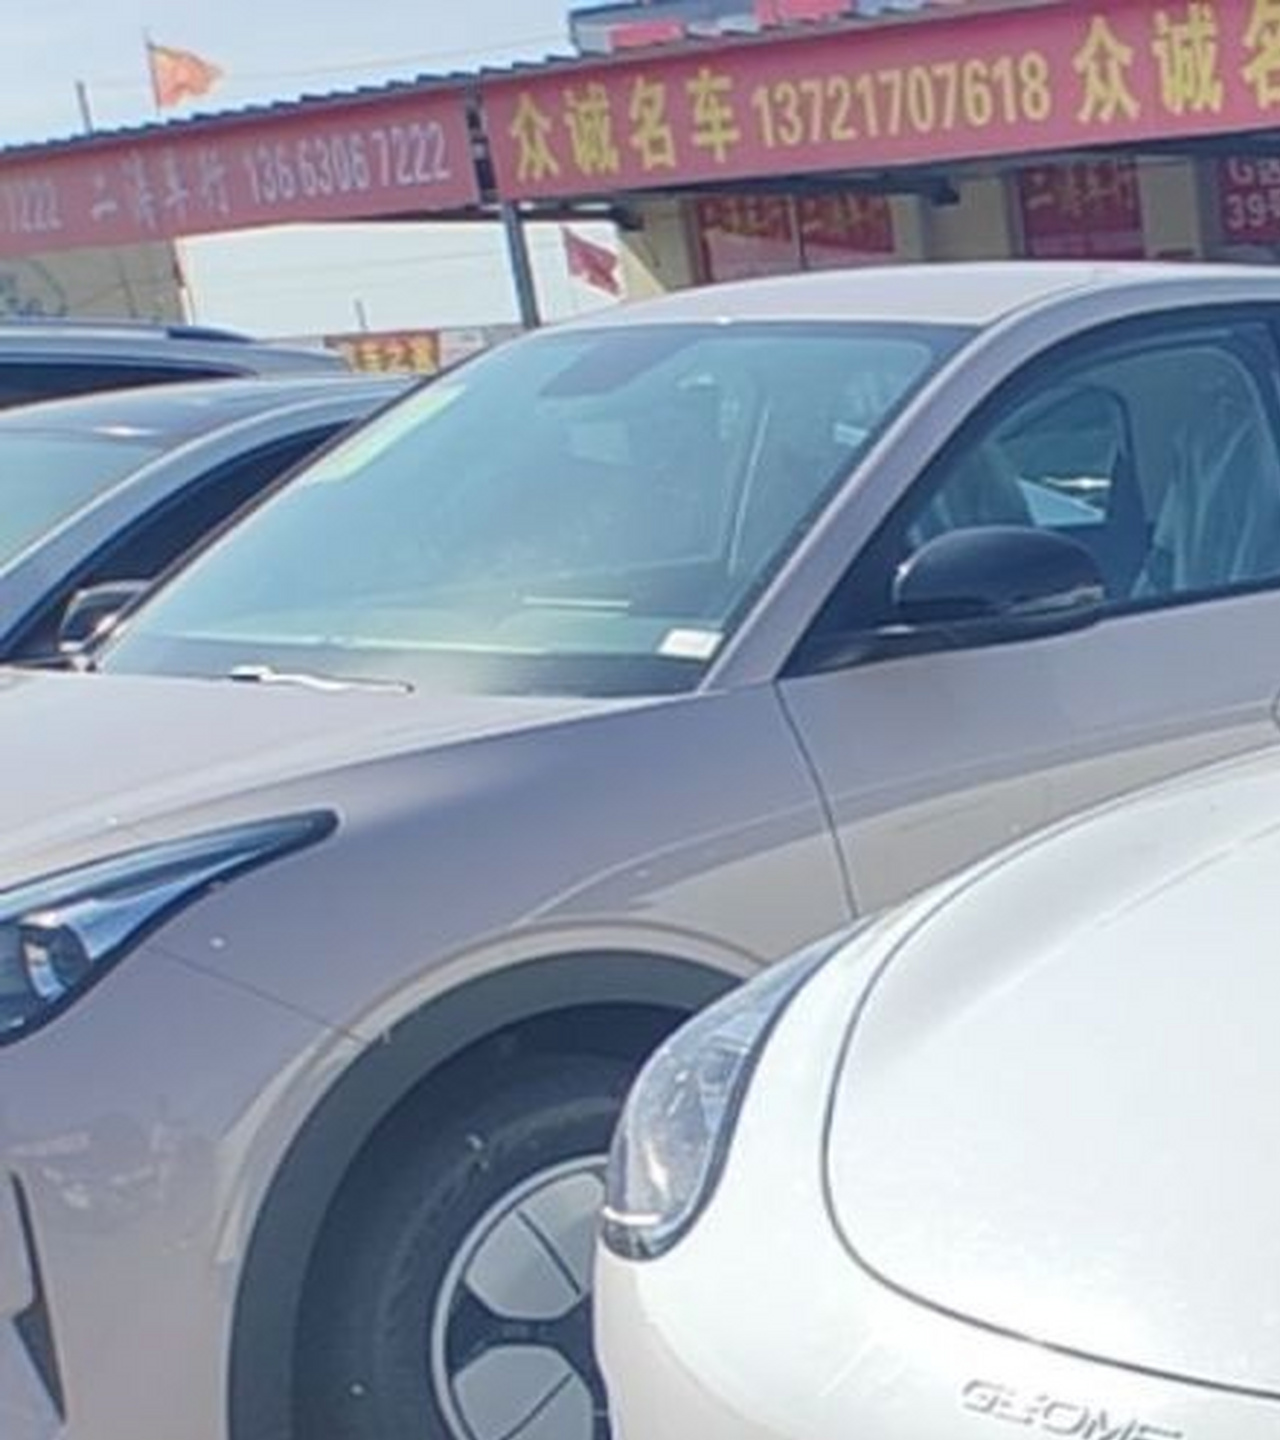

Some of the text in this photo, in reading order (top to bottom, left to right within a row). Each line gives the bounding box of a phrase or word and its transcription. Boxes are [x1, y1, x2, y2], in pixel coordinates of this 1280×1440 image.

[510, 68, 741, 182] 众诚名车
[751, 51, 1049, 148] 13721707618
